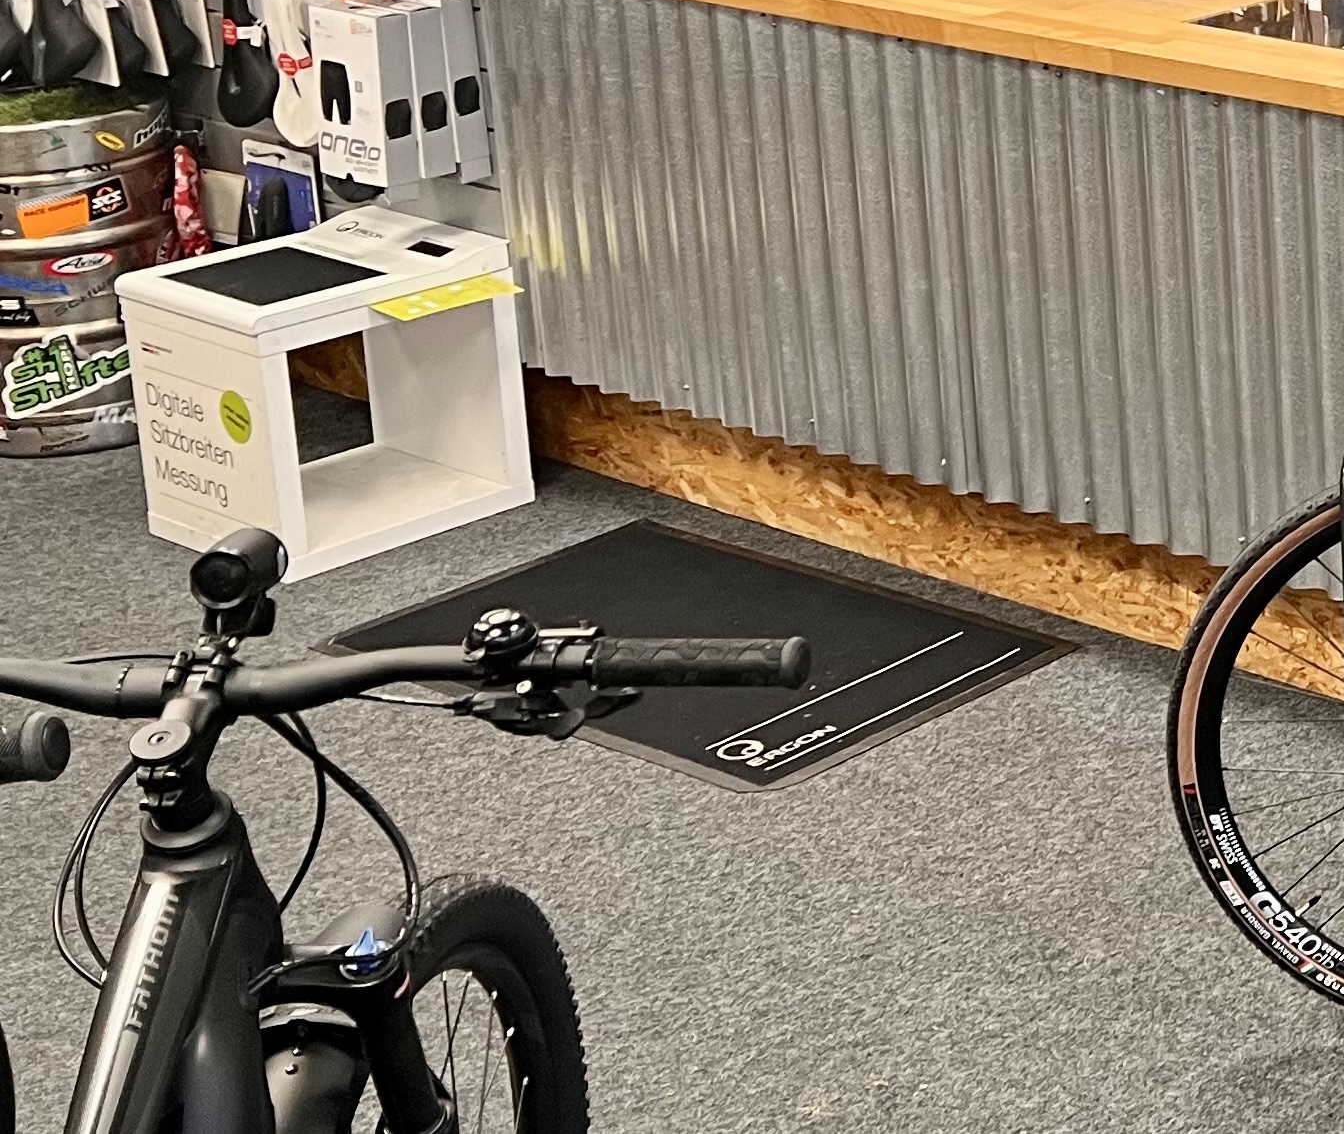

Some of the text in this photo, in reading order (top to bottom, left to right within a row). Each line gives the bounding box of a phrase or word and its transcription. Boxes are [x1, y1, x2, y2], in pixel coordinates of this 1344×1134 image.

[144, 381, 205, 424] Digitale
[150, 418, 235, 469] Sitzbreiten
[155, 455, 229, 508] Messung
[745, 724, 838, 768] ERGON
[1215, 833, 1239, 865] SWISS
[1270, 936, 1301, 965] GRAVEL
